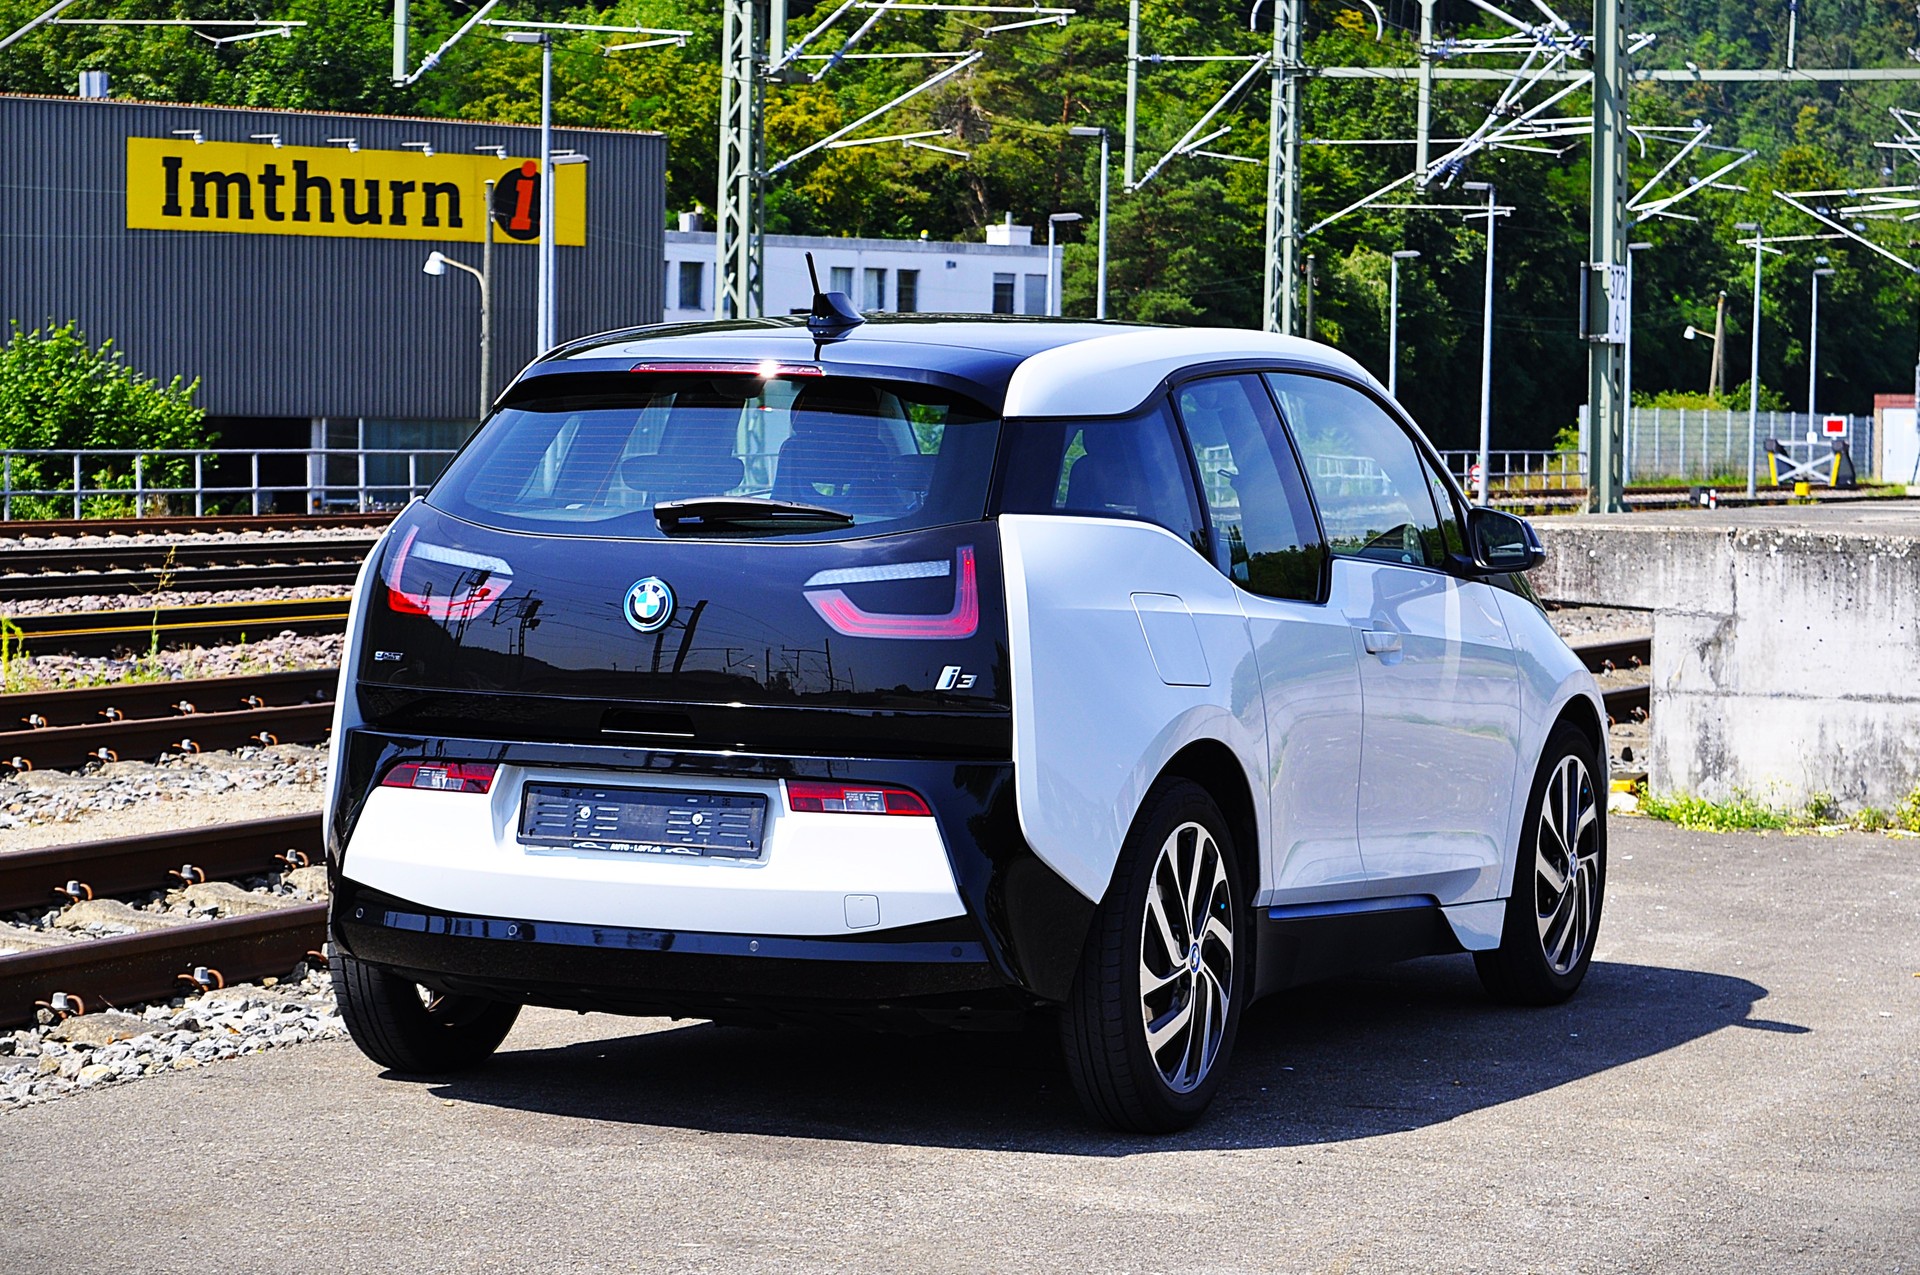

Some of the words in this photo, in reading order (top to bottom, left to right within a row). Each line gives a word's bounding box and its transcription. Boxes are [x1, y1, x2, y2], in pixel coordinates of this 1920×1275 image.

[161, 155, 463, 228] Imthurn
[1610, 270, 1626, 301] 372
[1614, 304, 1621, 334] 6
[631, 583, 666, 599] BMW
[935, 665, 978, 690] i3
